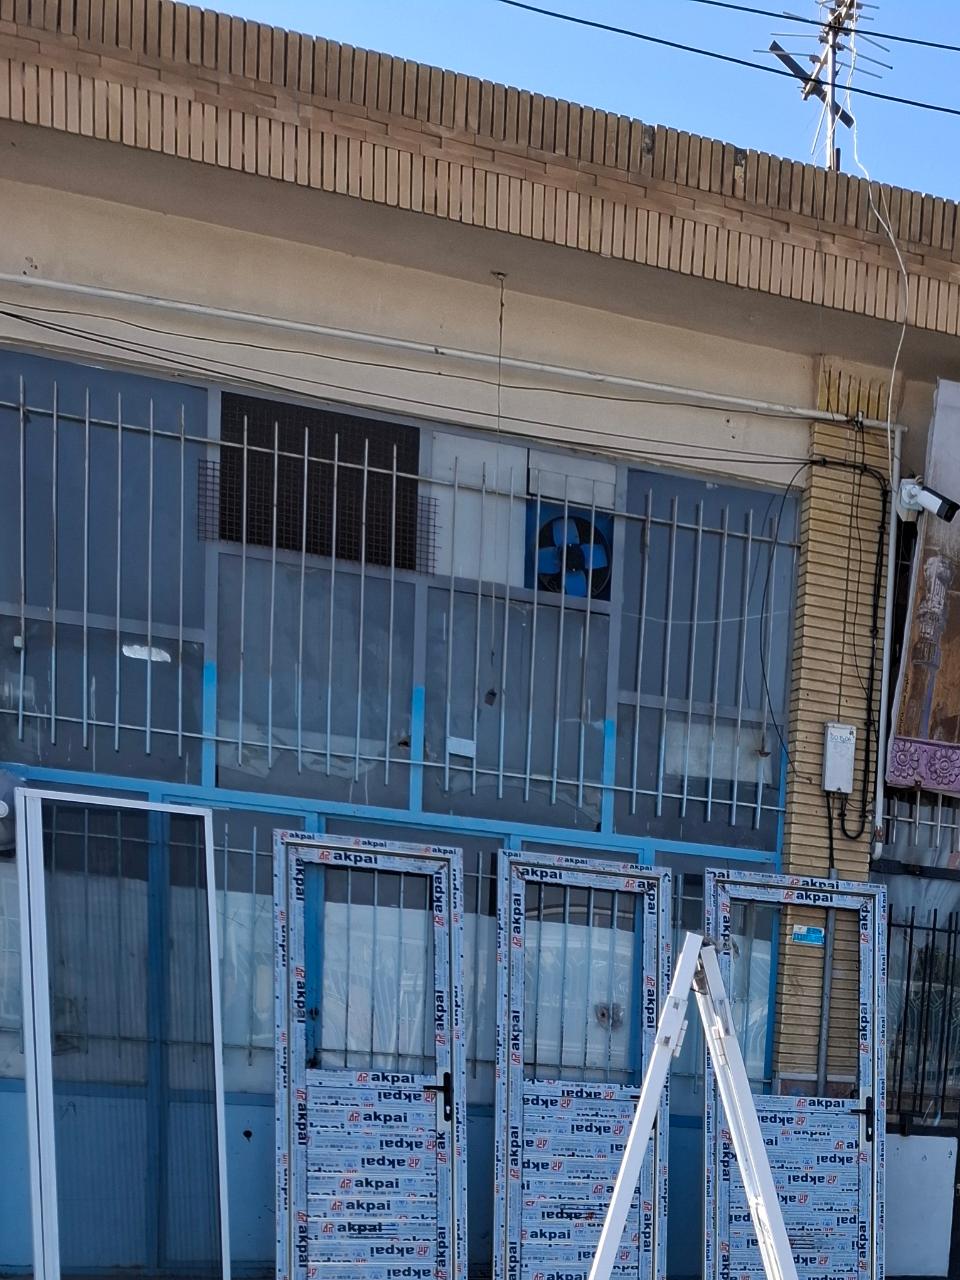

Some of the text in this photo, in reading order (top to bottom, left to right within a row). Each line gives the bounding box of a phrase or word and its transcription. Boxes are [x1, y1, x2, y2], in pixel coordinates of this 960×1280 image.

[334, 851, 378, 865] akpai
[522, 868, 562, 880] akpai
[434, 871, 445, 913] akpai
[796, 892, 833, 903] akpai
[513, 893, 522, 934] akpai
[861, 902, 870, 931] akp
[435, 990, 446, 1030] akpai
[647, 988, 655, 1029] akpai
[860, 1002, 868, 1041] akpai
[511, 1010, 521, 1050] akpai
[371, 1073, 415, 1085] akpai
[377, 1090, 422, 1102] akpai
[562, 1089, 601, 1099] akpai
[523, 1097, 558, 1108] akpa
[808, 1099, 845, 1109] akpai
[363, 1112, 407, 1124] akpai
[571, 1124, 611, 1135] akpai
[379, 1139, 424, 1150] akpai
[510, 1126, 519, 1167] akpai
[361, 1157, 406, 1169] akpai
[721, 1143, 730, 1182] akpai
[816, 1155, 853, 1165] akpai
[523, 1162, 549, 1171] akp
[355, 1178, 399, 1190] akpai
[788, 1174, 825, 1184] akpai
[346, 1201, 390, 1212] akpai
[337, 1223, 383, 1234] akpai
[644, 1213, 652, 1252] akpai
[530, 1230, 570, 1241] akpai
[370, 1246, 415, 1258] akpai
[437, 1227, 446, 1267] akpai
[508, 1241, 518, 1280] akpai
[387, 1268, 431, 1280] akpai
